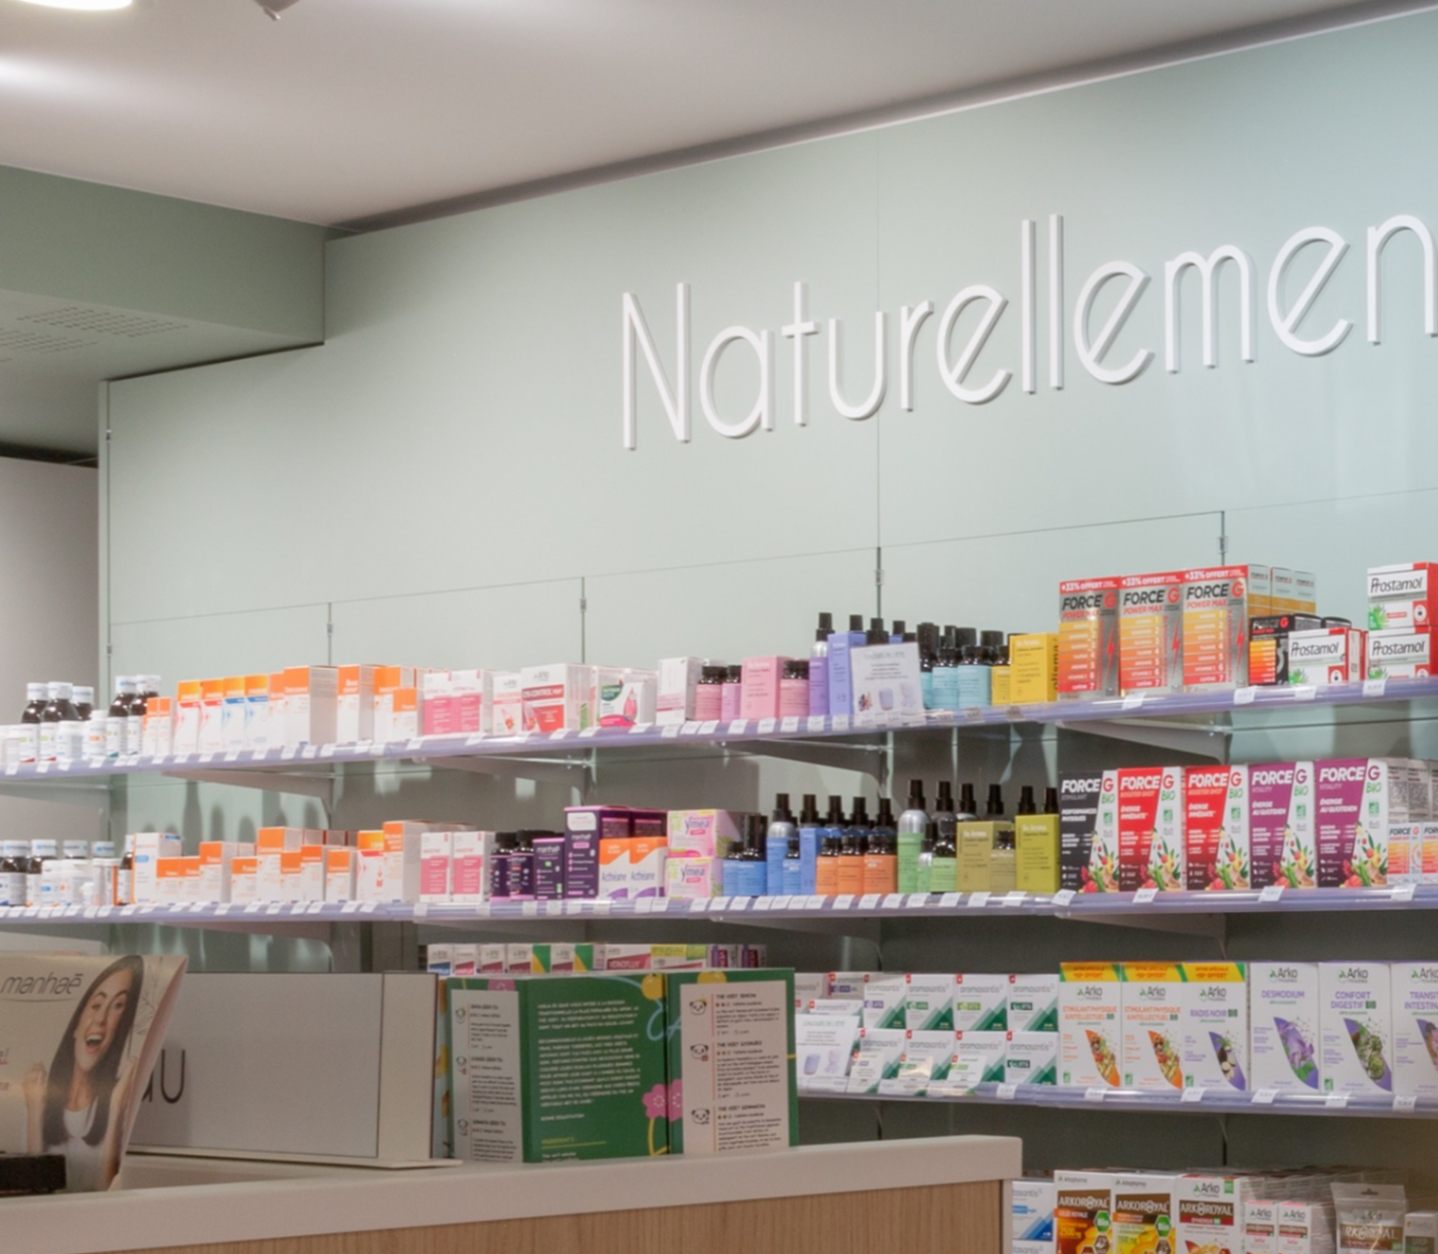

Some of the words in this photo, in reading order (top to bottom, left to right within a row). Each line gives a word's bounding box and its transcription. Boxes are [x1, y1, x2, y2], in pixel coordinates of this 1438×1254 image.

[1186, 582, 1230, 600] FORCE
[1231, 580, 1245, 598] G
[1369, 576, 1424, 594] Prostamol
[1290, 640, 1340, 657] Prostamol
[1371, 639, 1425, 658] Prostamol
[1188, 772, 1229, 789] FORCE
[1230, 771, 1242, 788] G
[1251, 769, 1294, 786] FORCE
[1295, 768, 1308, 785] G
[1319, 766, 1366, 783] FORCE
[1367, 764, 1381, 782] G
[1120, 775, 1161, 791] FORCE
[1162, 774, 1174, 790] G
[1365, 781, 1382, 794] BIO
[1261, 990, 1305, 999] DESMODIUM
[1335, 991, 1371, 1000] CONFORT
[1200, 1183, 1220, 1194] Arko
